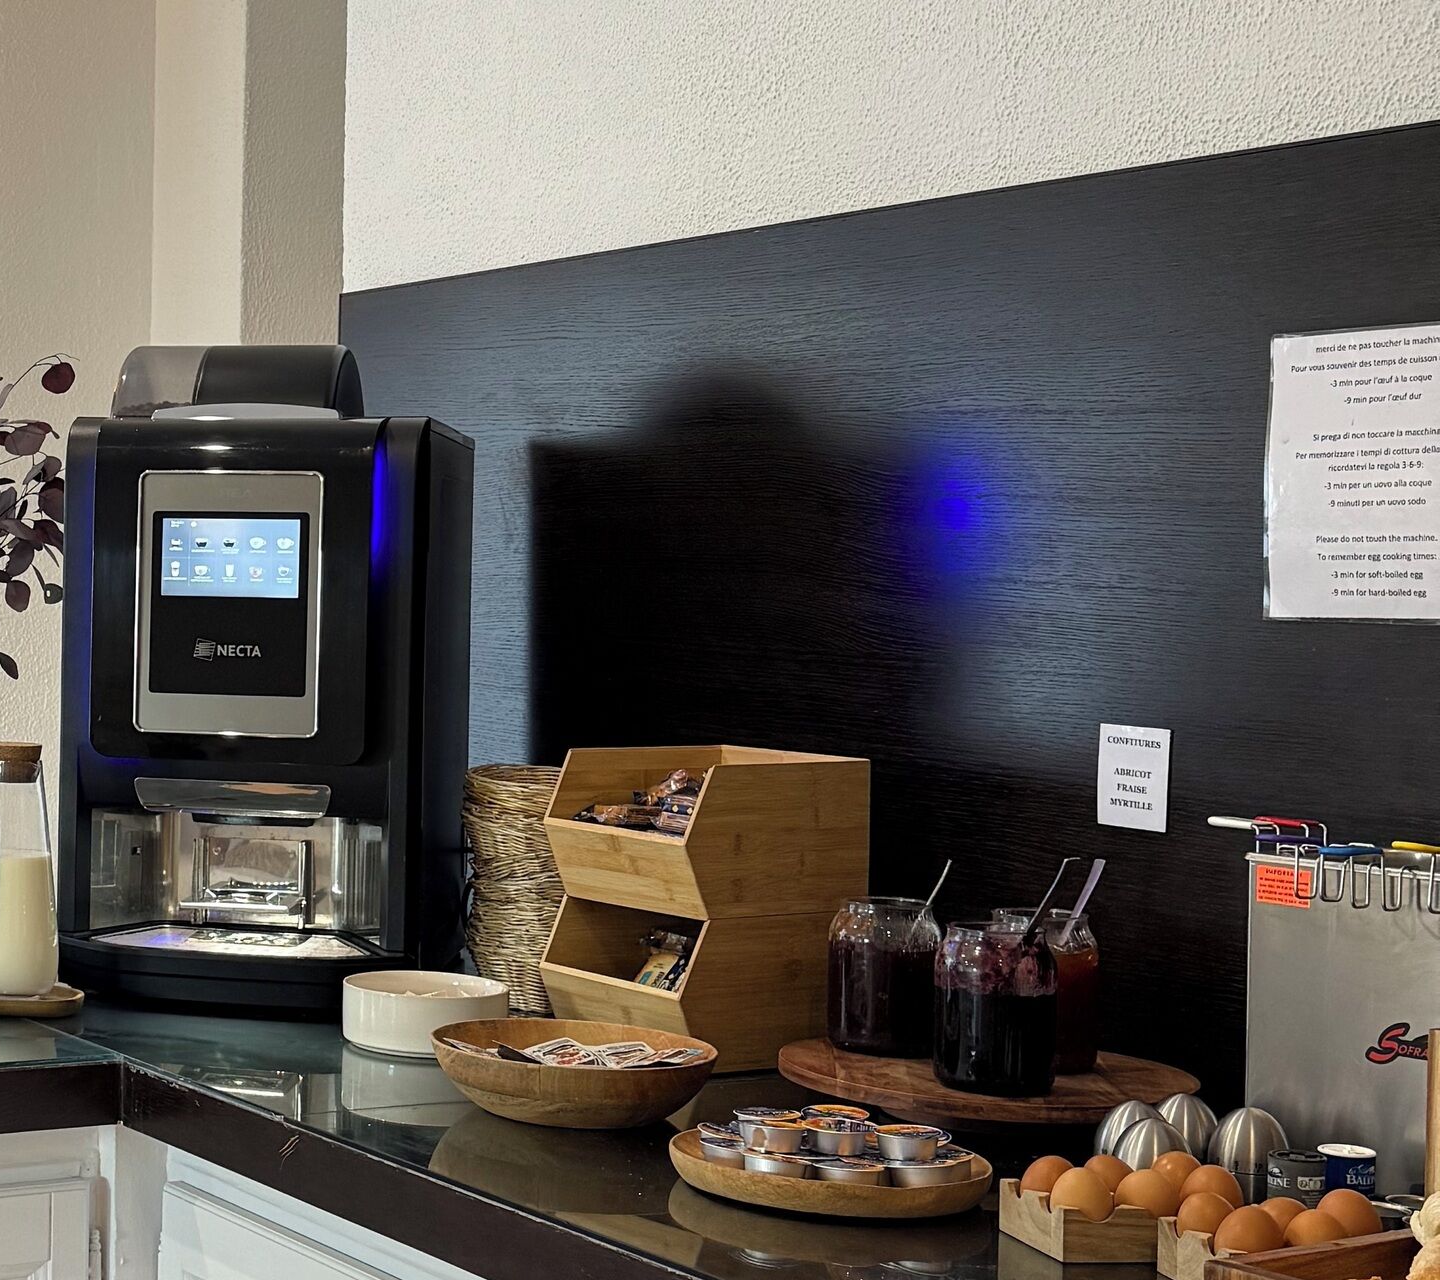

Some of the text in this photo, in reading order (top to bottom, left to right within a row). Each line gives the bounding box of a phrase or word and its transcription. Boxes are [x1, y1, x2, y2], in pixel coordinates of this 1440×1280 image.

[1359, 343, 1371, 351] pas
[1374, 339, 1401, 348] toucher
[1412, 335, 1440, 344] machin
[1327, 362, 1357, 370] souvenir
[1374, 359, 1396, 367] temps
[1409, 356, 1437, 364] cuisson
[1355, 378, 1372, 386] pour
[1409, 374, 1432, 382] coque
[1409, 392, 1421, 400] dur
[1321, 433, 1341, 442] prega
[1309, 450, 1354, 458] memorizzare
[1361, 449, 1382, 457] tempi
[1377, 462, 1400, 471] regola
[1349, 482, 1361, 490] per
[1409, 480, 1432, 488] coque
[1337, 499, 1360, 507] minuti
[1316, 535, 1338, 543] Please
[1340, 535, 1350, 543] do
[1389, 534, 1401, 542] the
[1383, 553, 1411, 561] cooking
[217, 644, 262, 657] NECTA
[1107, 735, 1162, 749] CONFITURES
[1113, 767, 1153, 780] ABRICOT
[1116, 783, 1148, 795] FRAISE
[1109, 797, 1153, 811] MYRTILLE
